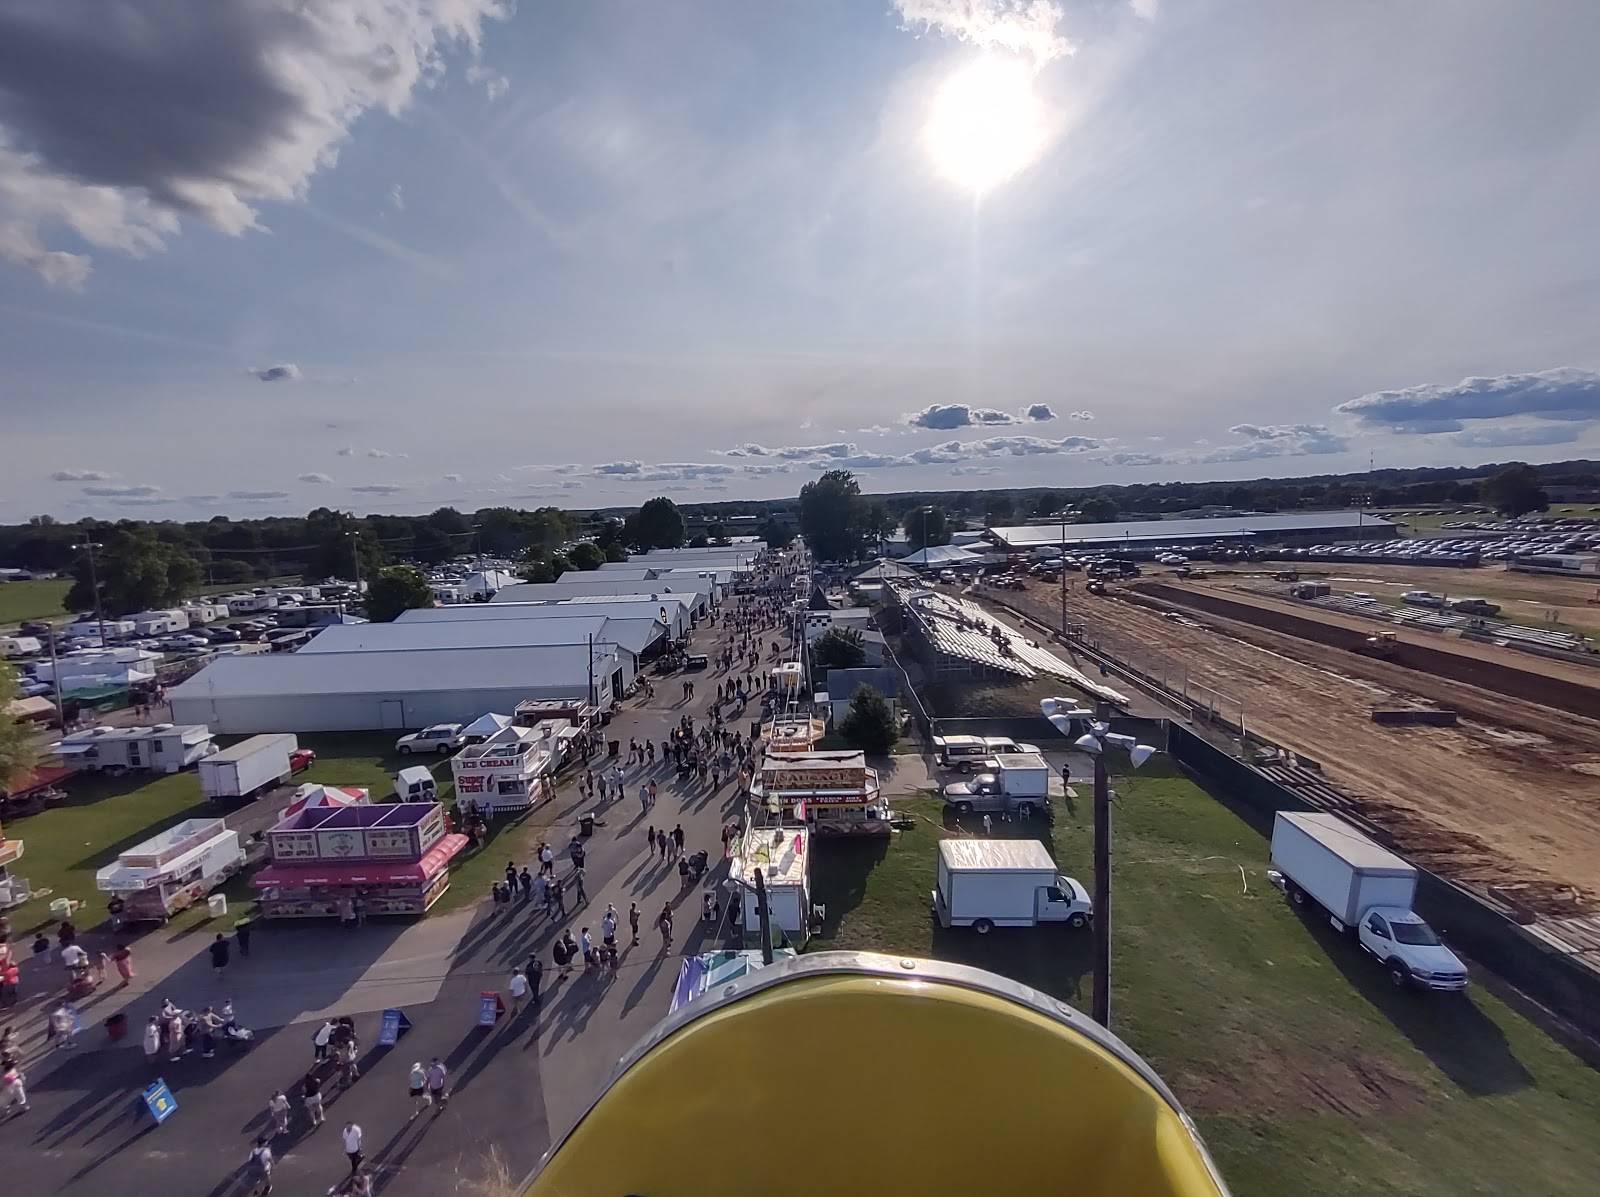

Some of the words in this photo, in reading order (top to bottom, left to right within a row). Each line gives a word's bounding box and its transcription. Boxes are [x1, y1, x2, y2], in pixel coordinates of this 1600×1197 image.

[462, 761, 478, 769] ICE
[480, 759, 515, 768] CREAM
[176, 852, 212, 877] LEMONADE
